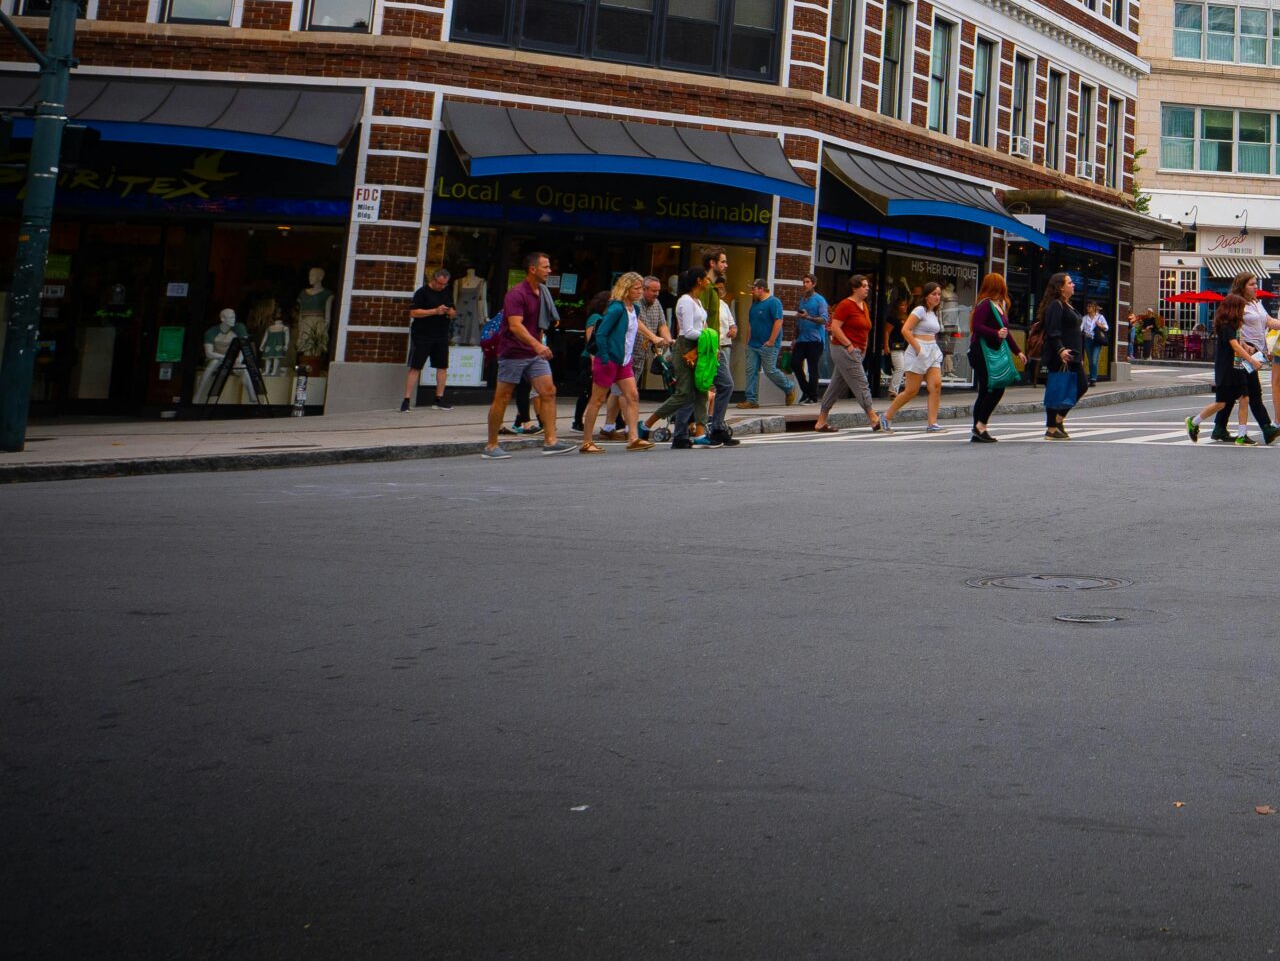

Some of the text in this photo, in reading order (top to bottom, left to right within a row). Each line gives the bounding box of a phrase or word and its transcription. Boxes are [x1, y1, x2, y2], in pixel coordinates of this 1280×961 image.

[356, 188, 379, 201] FDC
[438, 176, 771, 224] Local Organic Sustainable
[818, 244, 850, 267] ION
[911, 260, 924, 272] HIS
[942, 265, 976, 280] BOUTIQUE
